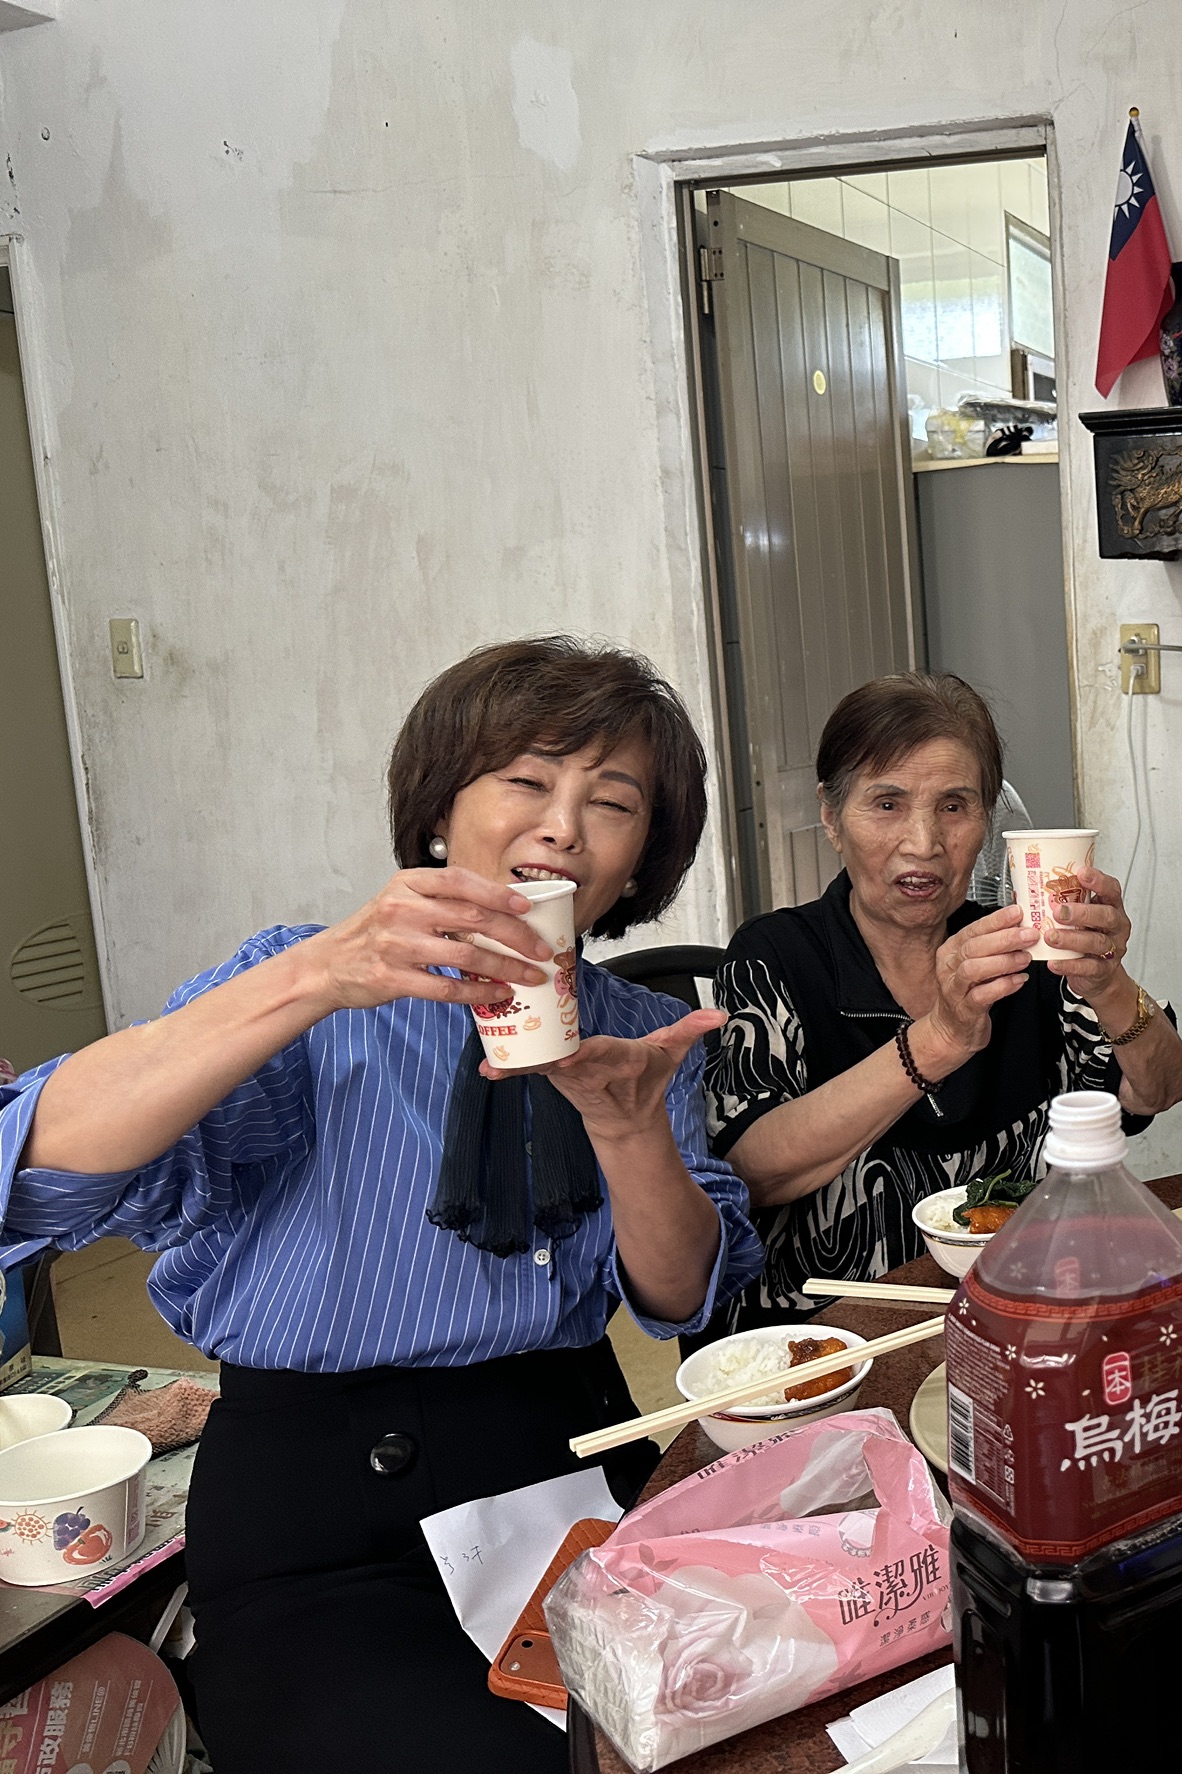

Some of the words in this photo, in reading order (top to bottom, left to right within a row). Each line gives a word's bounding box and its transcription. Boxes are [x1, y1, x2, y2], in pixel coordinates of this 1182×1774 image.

[478, 1025, 518, 1037] OFFEE
[838, 1543, 942, 1627] 唯潔雅
